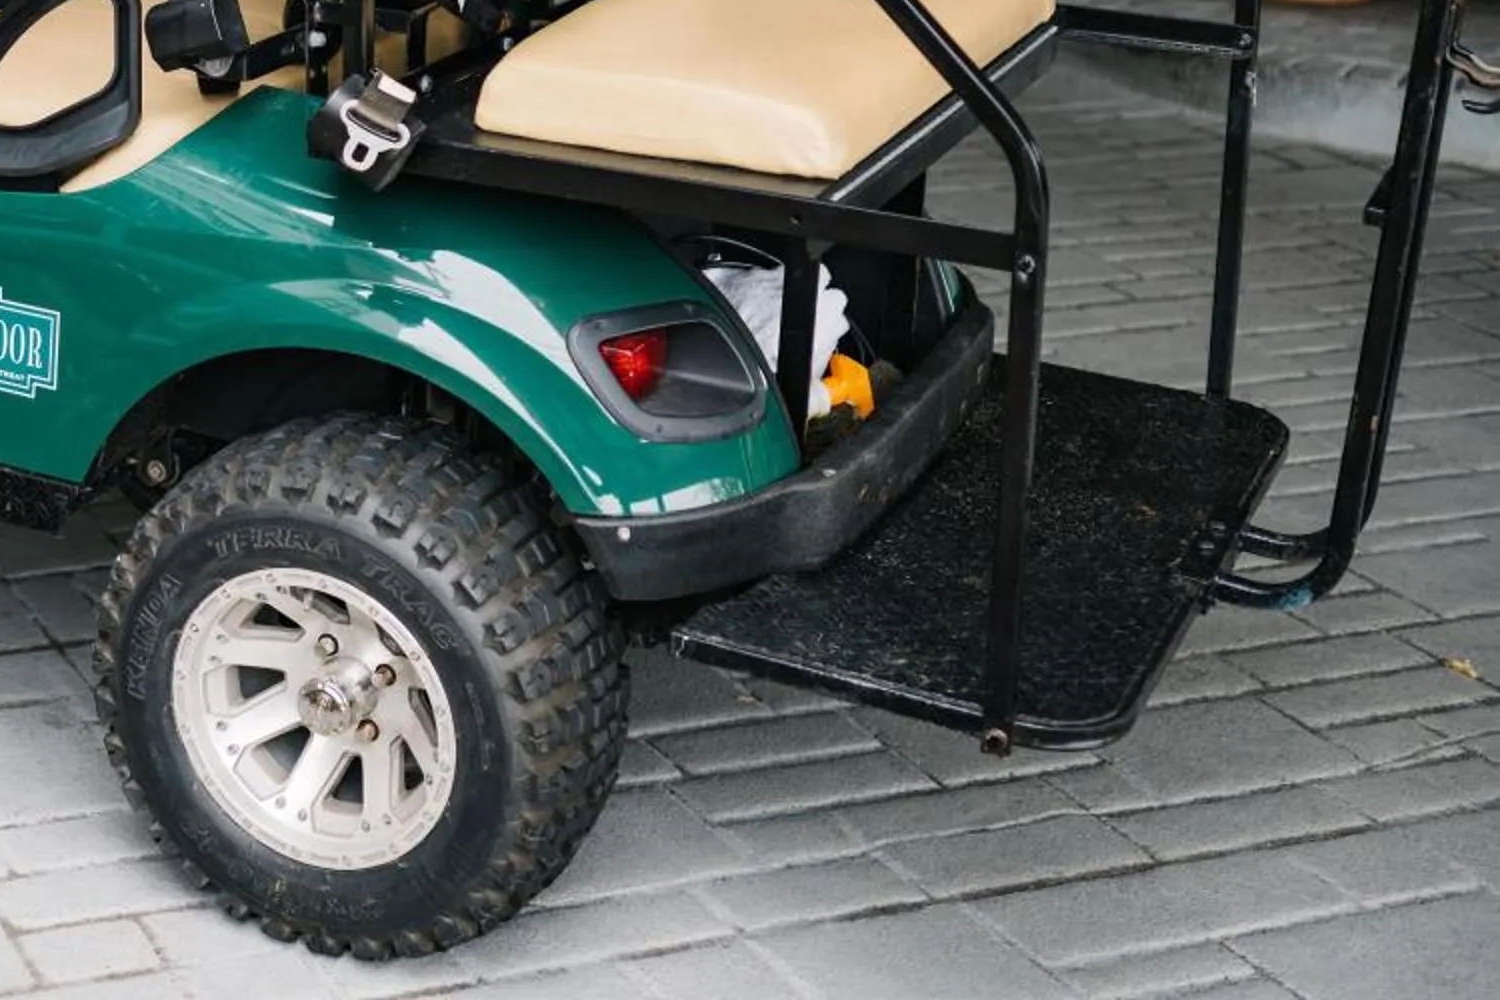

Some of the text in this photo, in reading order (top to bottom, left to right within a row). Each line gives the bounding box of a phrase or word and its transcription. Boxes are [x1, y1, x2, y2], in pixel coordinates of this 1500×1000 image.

[126, 572, 182, 700] KENDA
[205, 527, 459, 651] TERRA TRAC
